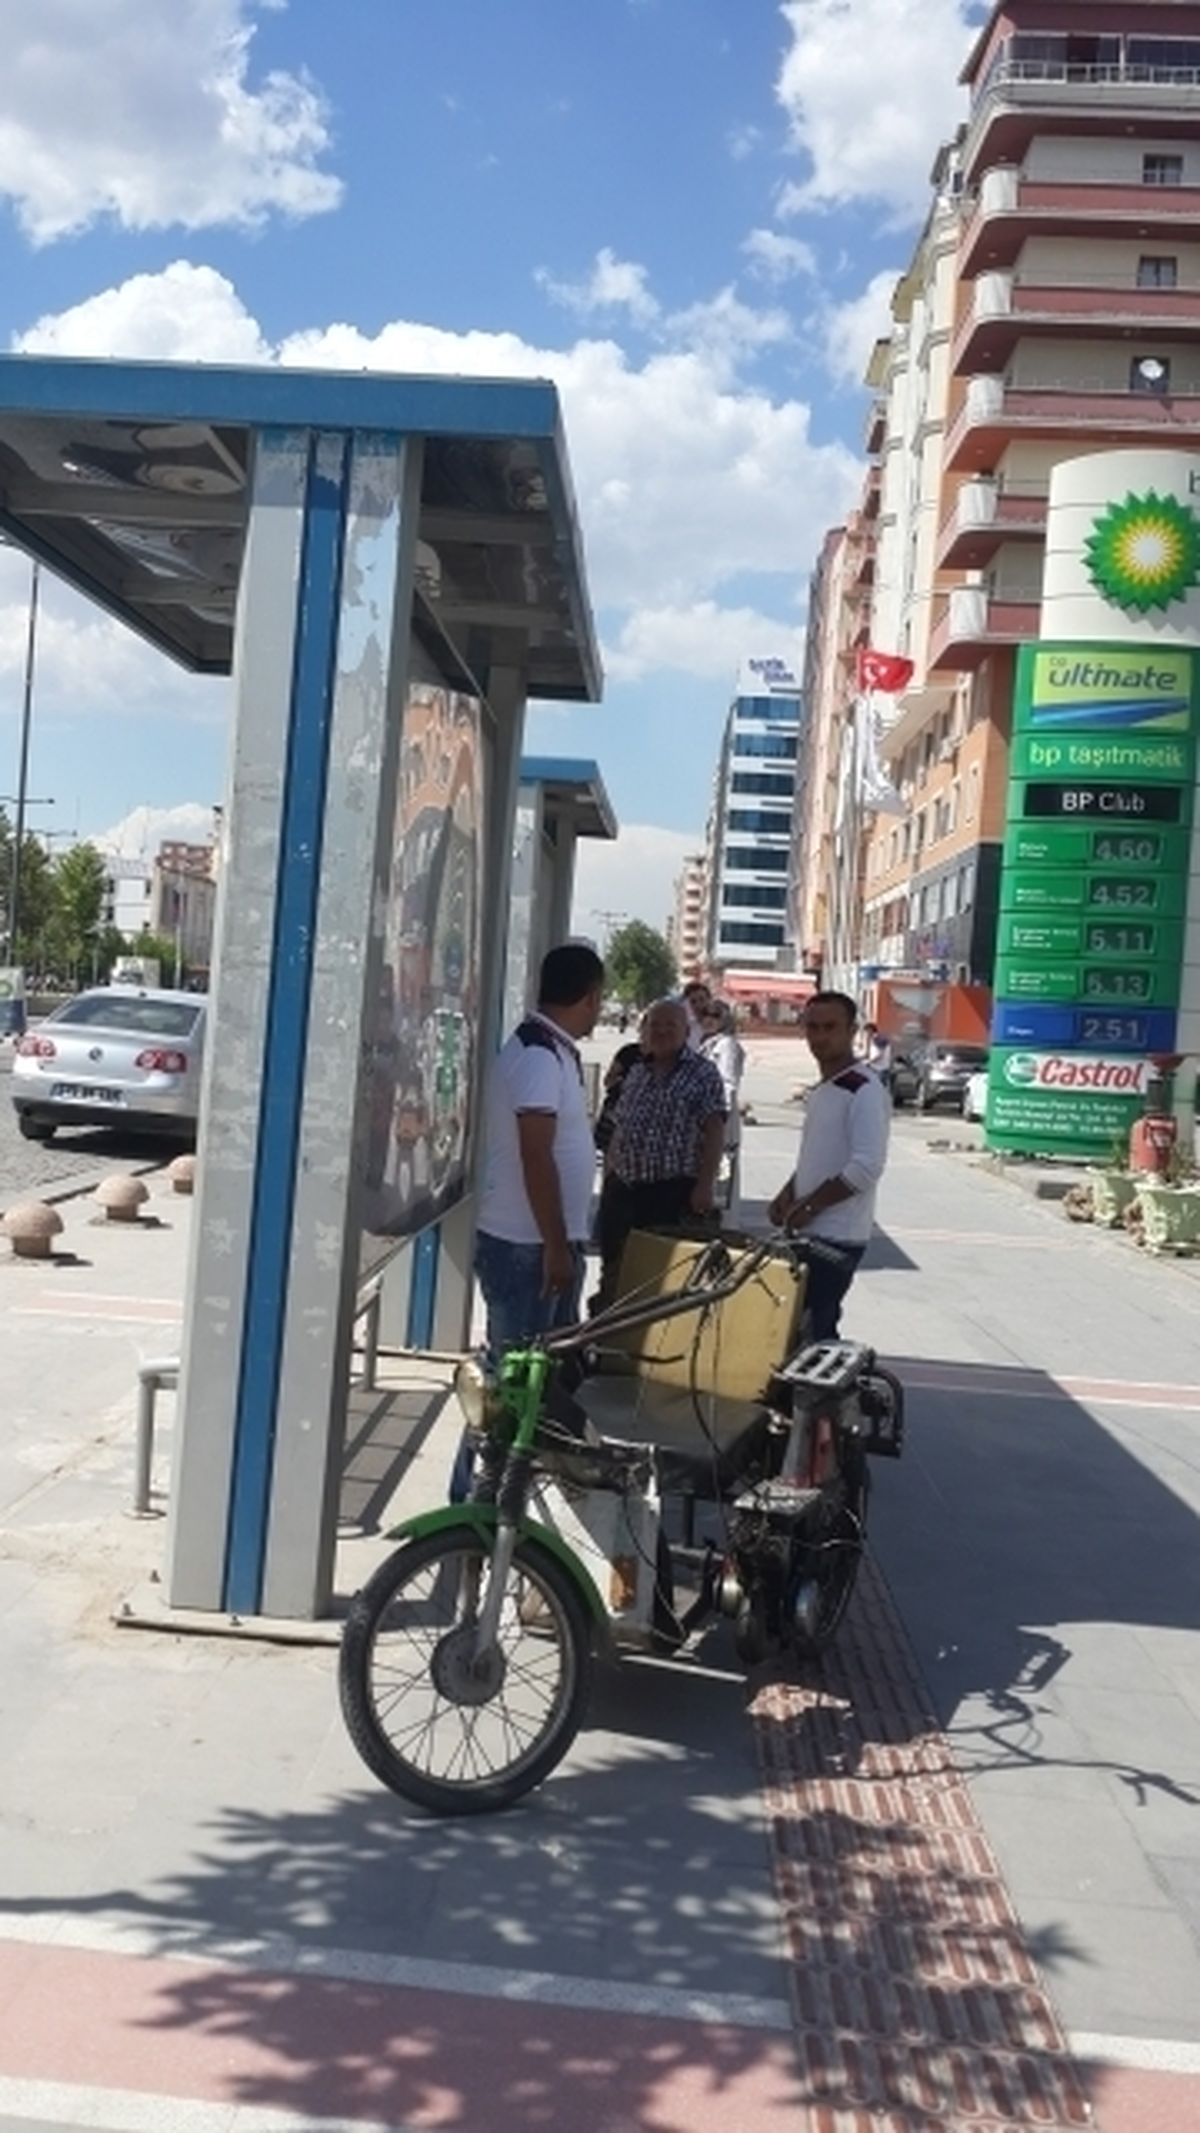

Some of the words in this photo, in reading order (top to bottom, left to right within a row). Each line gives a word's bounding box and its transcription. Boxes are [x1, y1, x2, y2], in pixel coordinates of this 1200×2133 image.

[1049, 662, 1178, 691] ultimate
[1029, 742, 1061, 767] bp
[1069, 743, 1183, 768] taşıtmatik
[1062, 792, 1094, 811] BP
[1099, 792, 1146, 811] Club
[1092, 885, 1149, 907] 4.52
[1089, 928, 1146, 950] 5.11
[1040, 1057, 1144, 1088] Castrol
